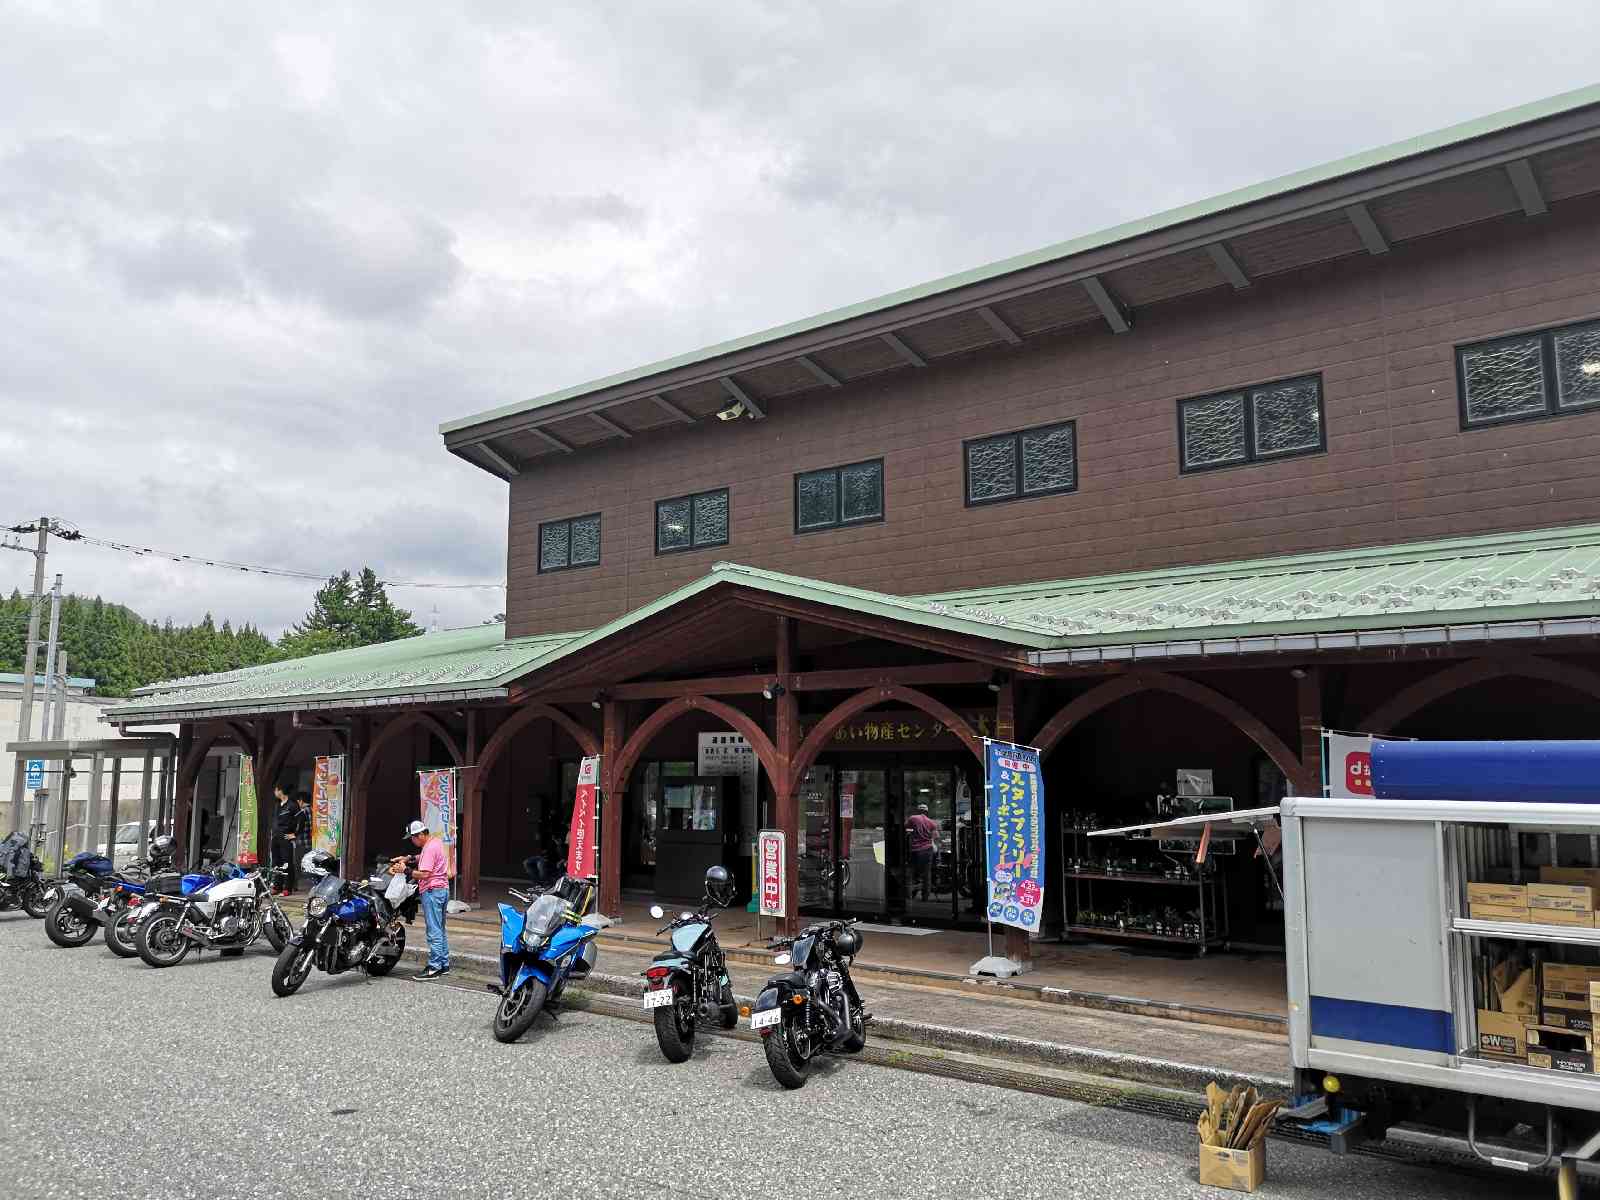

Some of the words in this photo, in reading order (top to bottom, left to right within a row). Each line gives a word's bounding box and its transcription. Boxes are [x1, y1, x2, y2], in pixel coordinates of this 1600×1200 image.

[1011, 771, 1025, 878] スタンプラリー
[765, 840, 778, 908] 営業中です
